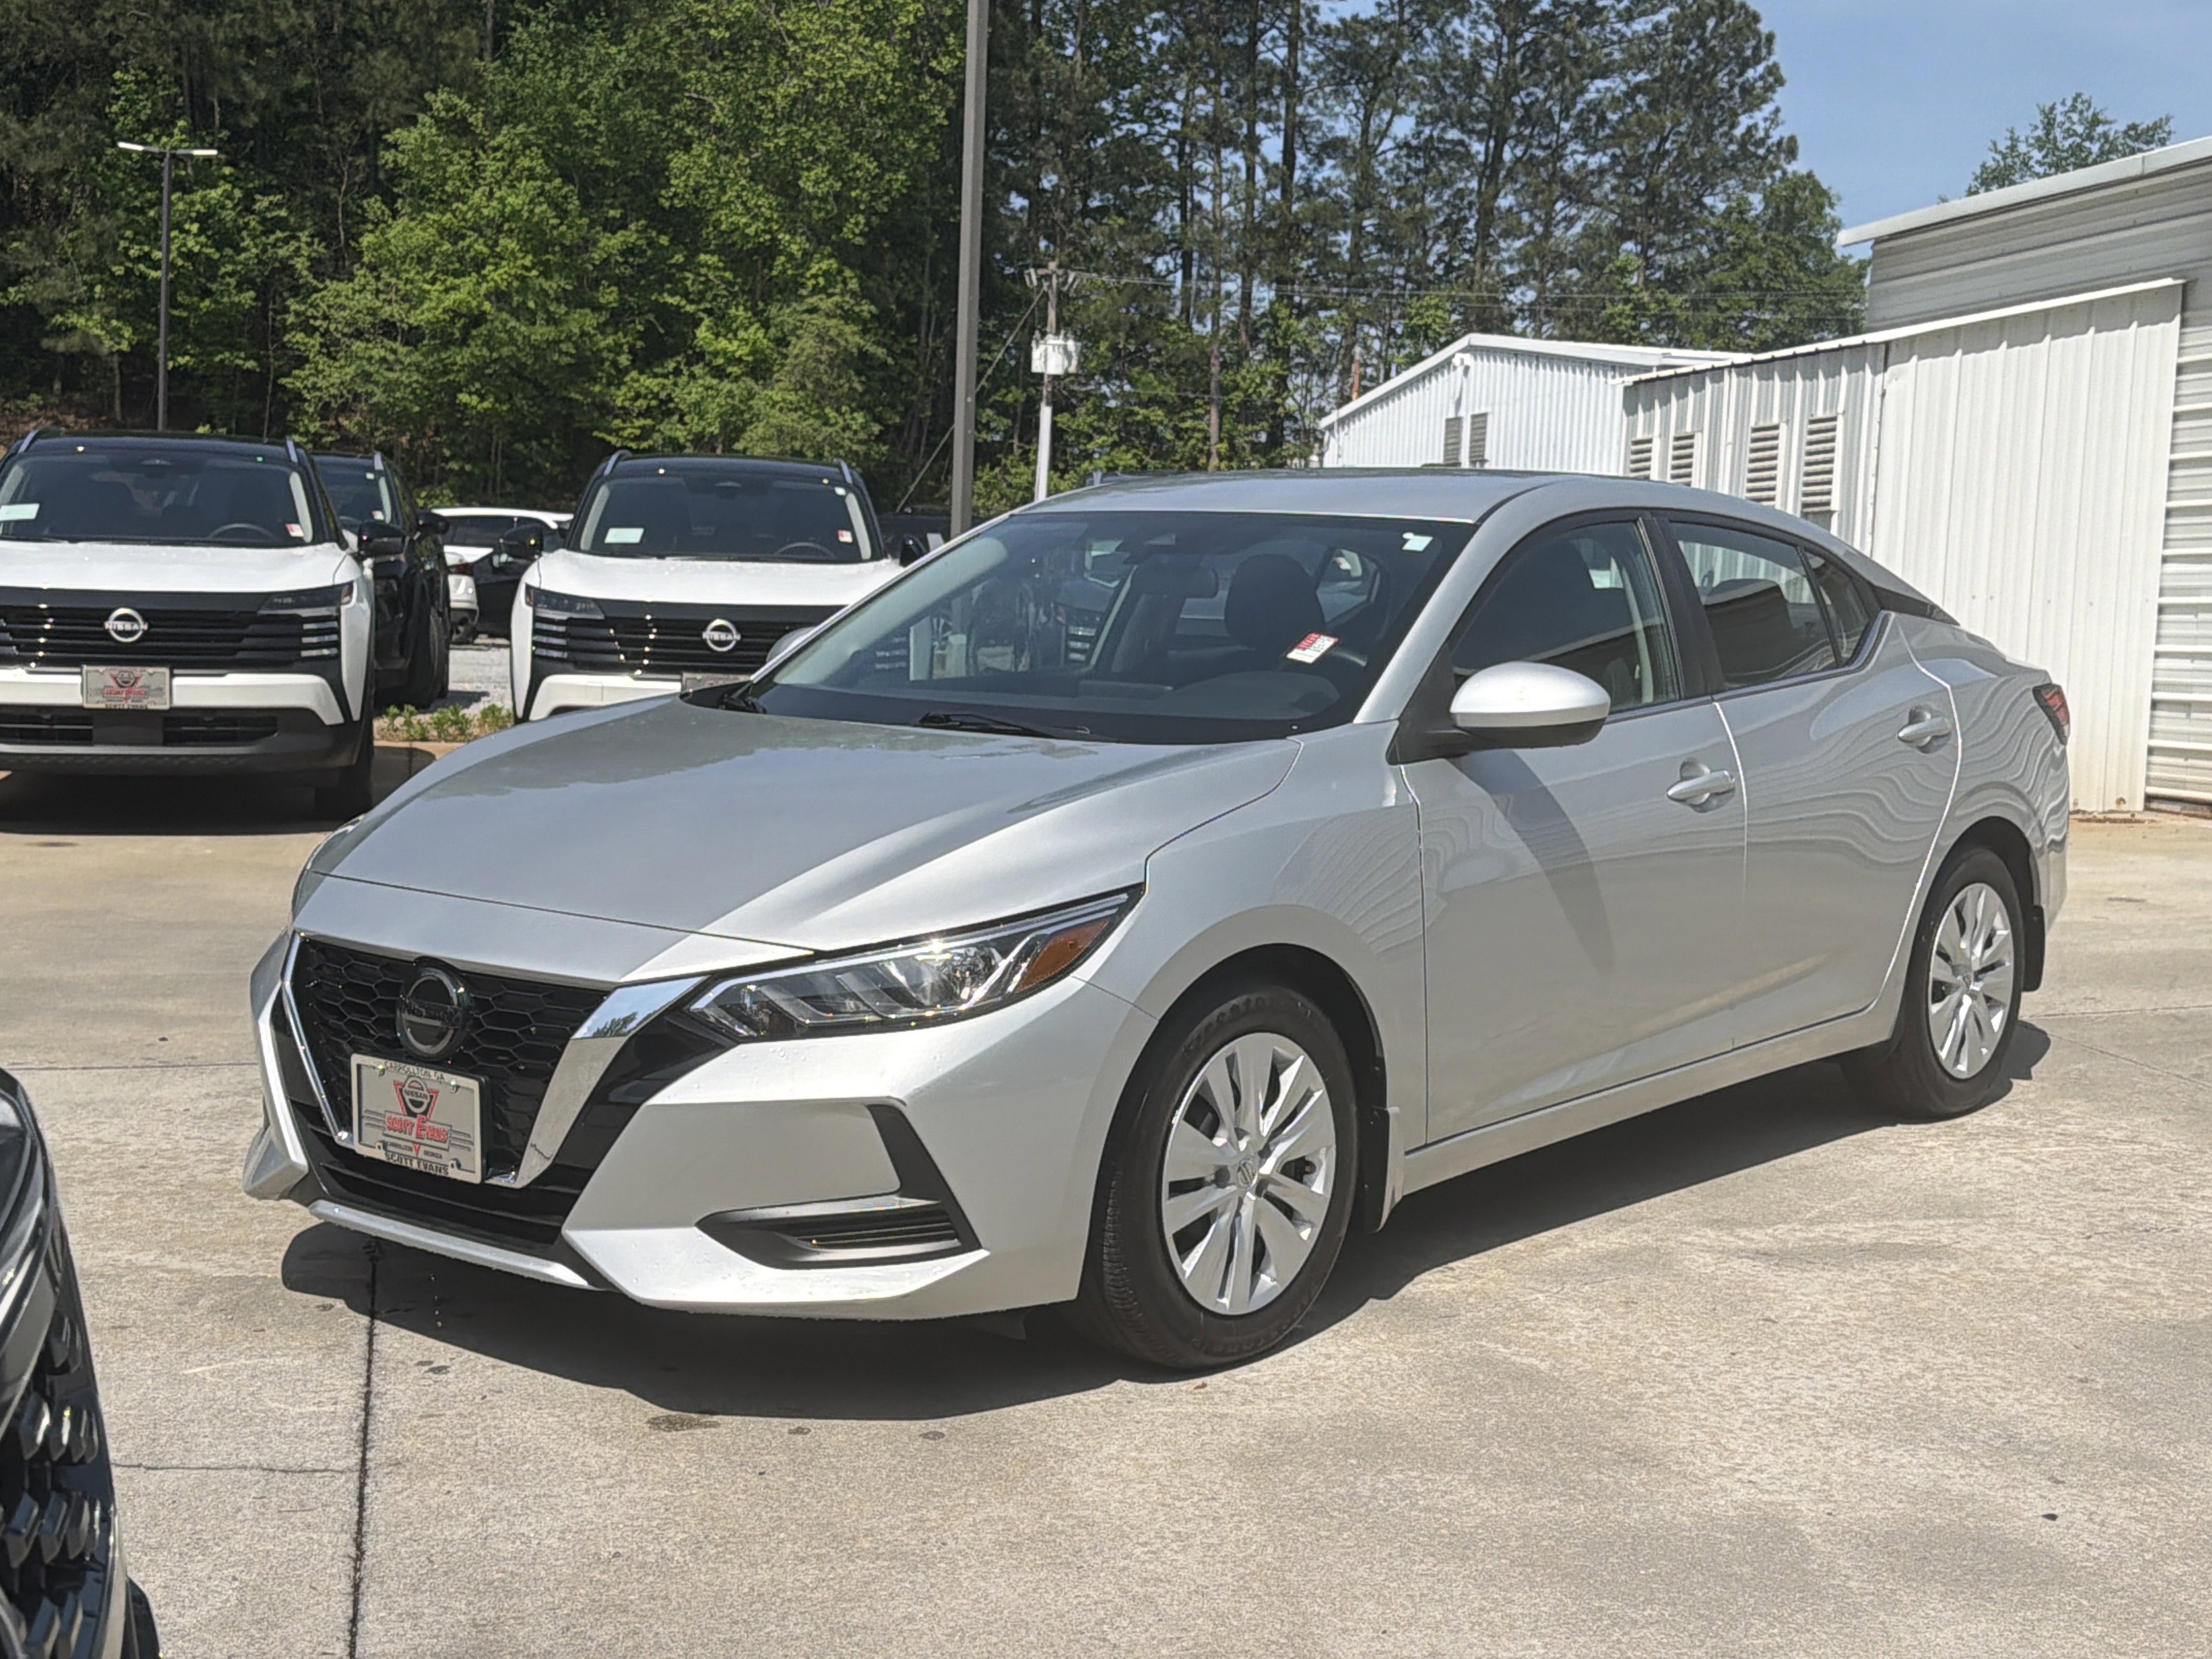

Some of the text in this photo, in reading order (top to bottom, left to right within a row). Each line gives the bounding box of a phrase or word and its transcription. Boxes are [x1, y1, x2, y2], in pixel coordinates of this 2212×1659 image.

[386, 1116, 415, 1136] SCOTT
[385, 1152, 448, 1175] SCOTT EVANS
